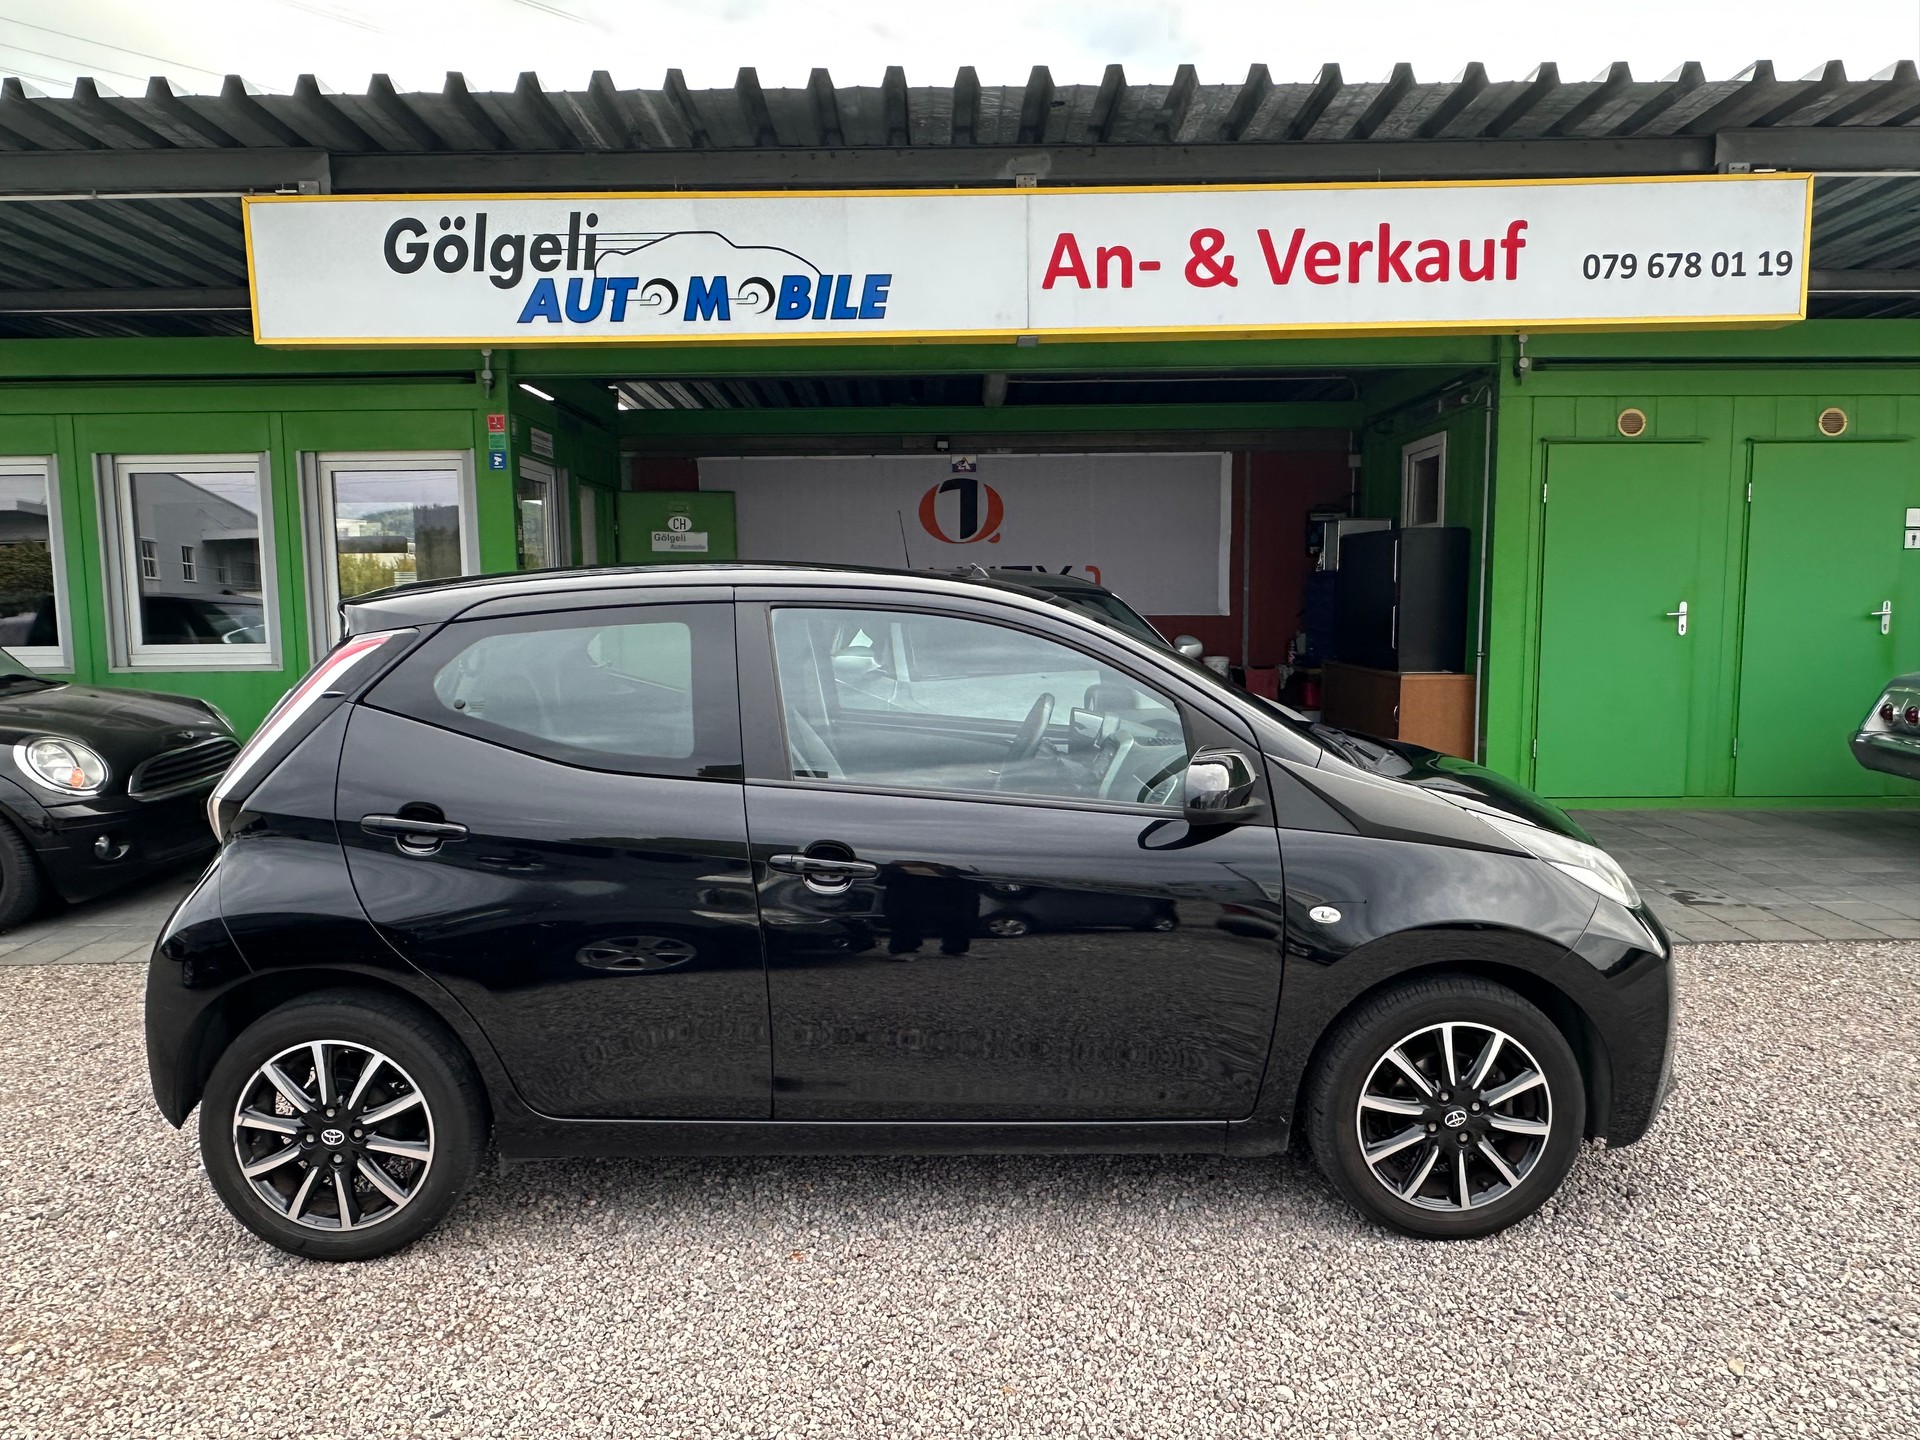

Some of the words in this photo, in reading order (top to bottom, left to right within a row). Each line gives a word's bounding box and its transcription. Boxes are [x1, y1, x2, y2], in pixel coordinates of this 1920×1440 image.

[384, 212, 598, 289] Gölgeli
[1042, 232, 1160, 290] An-
[1185, 228, 1238, 288] &
[1258, 219, 1528, 288] Verkauf
[1582, 253, 1637, 280] 079
[1647, 252, 1702, 279] 678
[1711, 251, 1747, 278] 01
[1758, 250, 1793, 277] 19
[673, 518, 686, 530] CH
